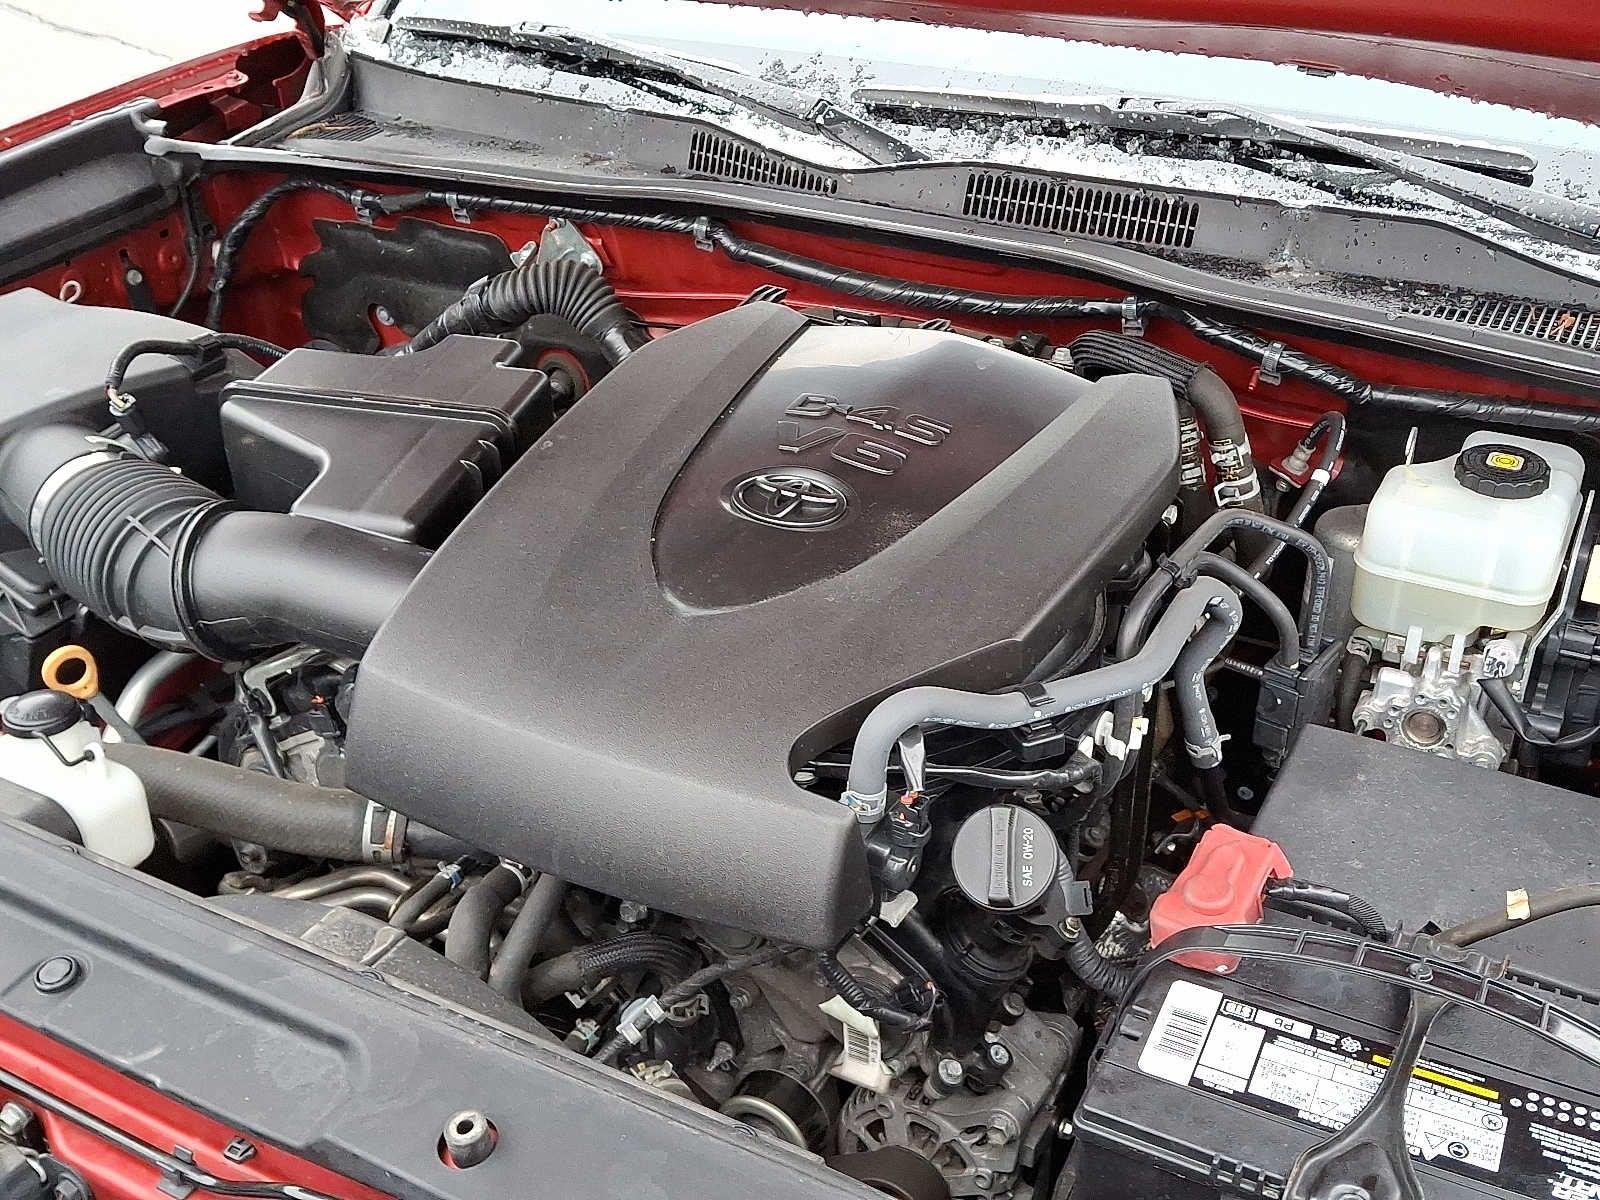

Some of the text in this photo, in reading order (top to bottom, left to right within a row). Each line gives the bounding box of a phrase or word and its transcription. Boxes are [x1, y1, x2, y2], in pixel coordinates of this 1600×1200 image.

[784, 392, 953, 446] D-4S
[777, 420, 911, 475] V6
[1022, 827, 1034, 887] SAE 0W-20
[1274, 1017, 1295, 1031] Pb
